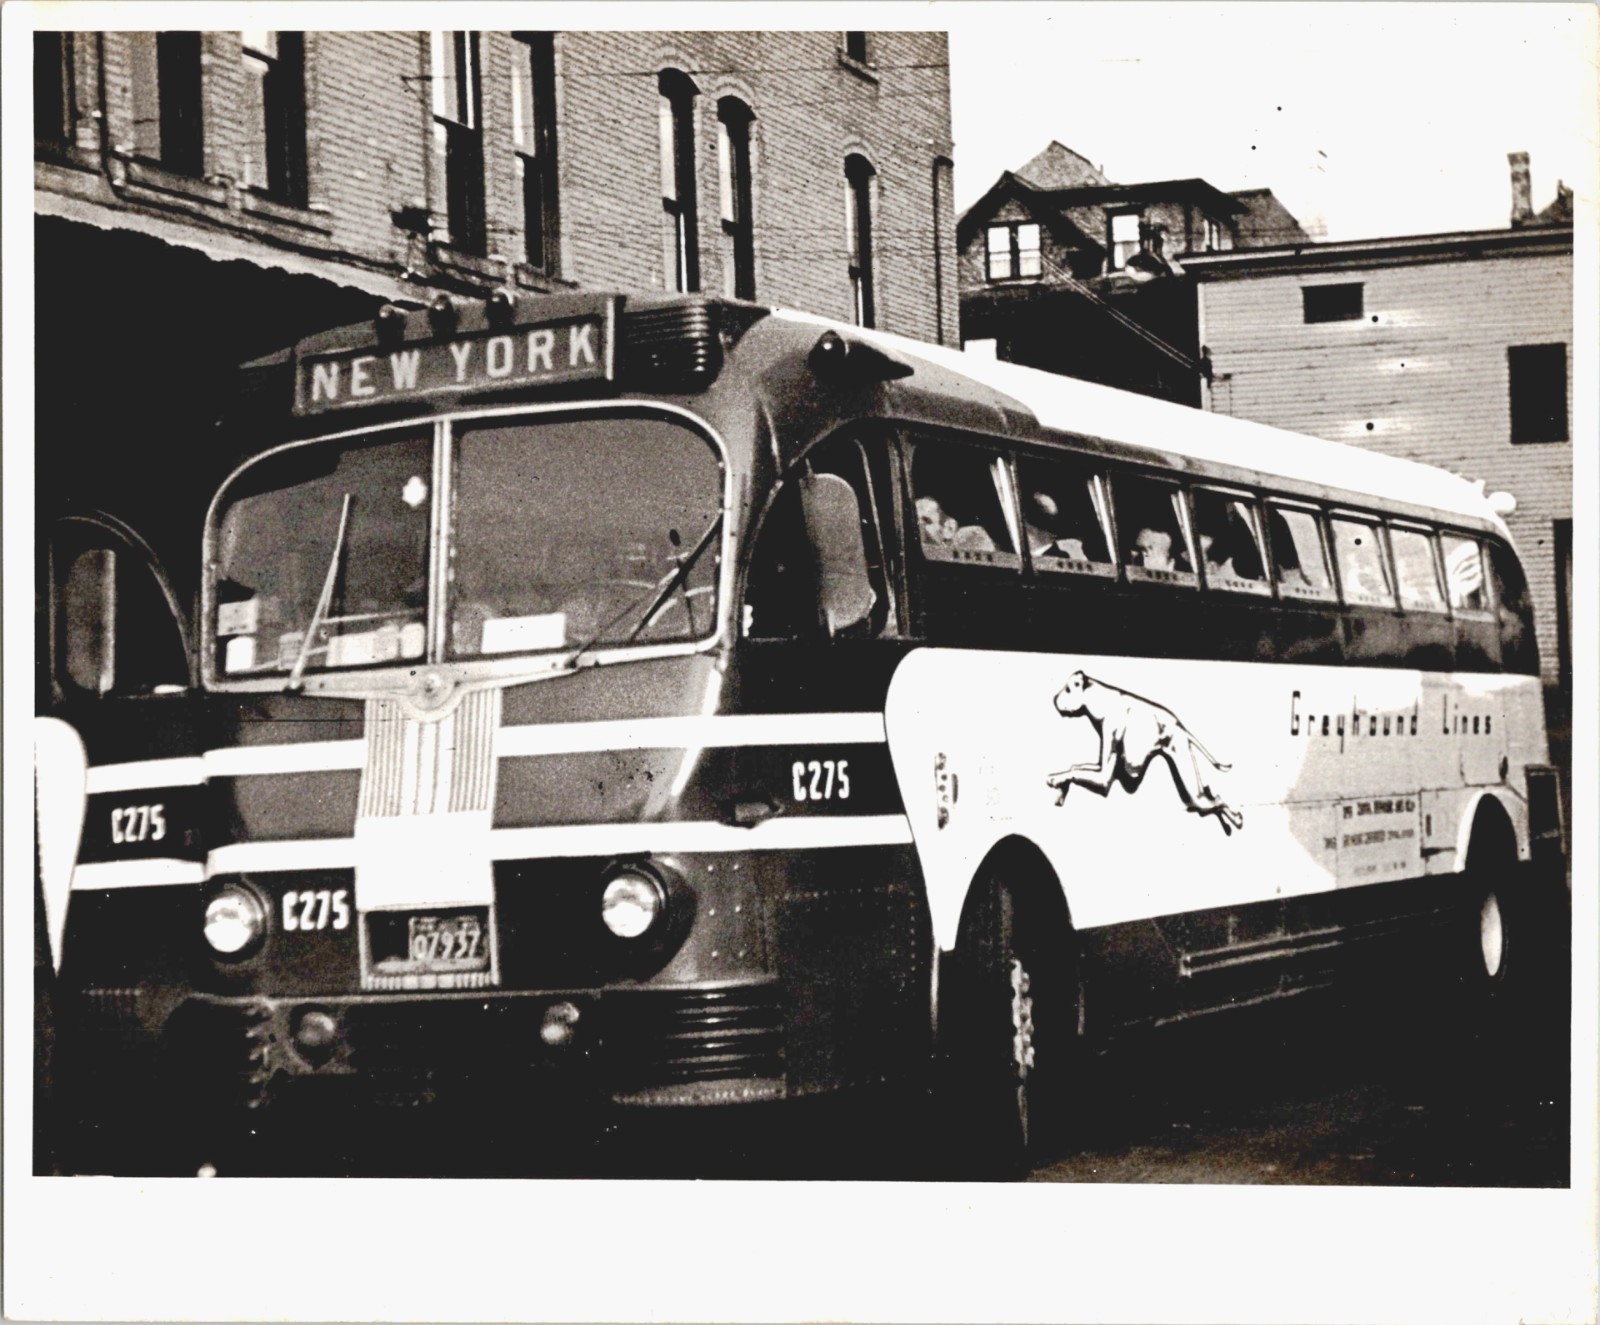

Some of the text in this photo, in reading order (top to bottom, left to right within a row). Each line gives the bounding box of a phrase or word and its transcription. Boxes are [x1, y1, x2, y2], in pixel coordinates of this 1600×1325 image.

[312, 323, 595, 401] NEW YORK
[1291, 690, 1491, 754] Greyhound Lines
[792, 760, 850, 801] C275
[111, 804, 166, 844] C275
[282, 889, 350, 931] C275
